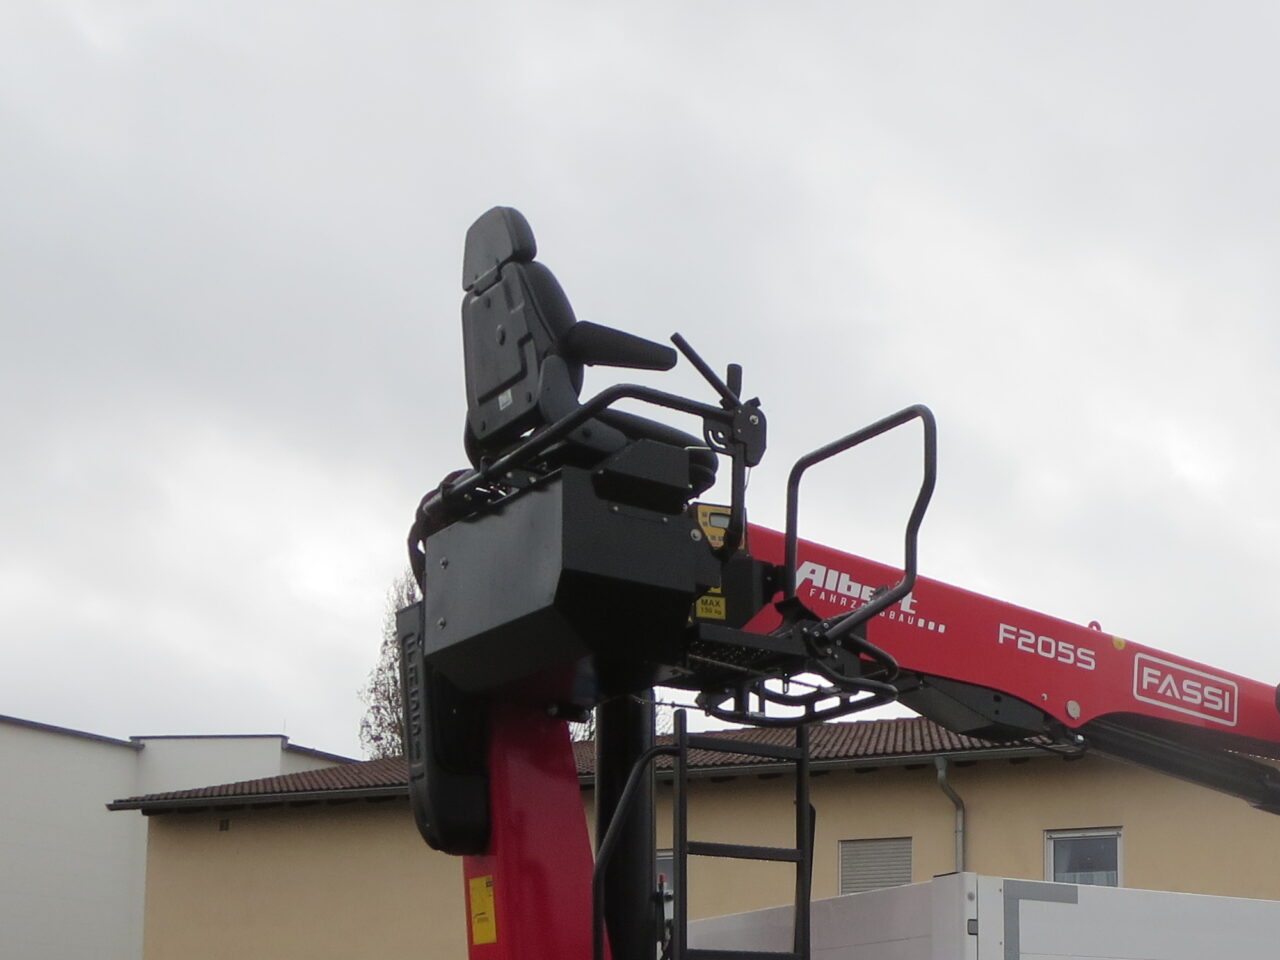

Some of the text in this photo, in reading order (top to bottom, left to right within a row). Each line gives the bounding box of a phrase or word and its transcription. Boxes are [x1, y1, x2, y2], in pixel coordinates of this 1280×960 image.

[701, 599, 720, 607] MAX
[796, 561, 917, 614] Albet
[998, 623, 1095, 670] F205S
[1142, 667, 1230, 713] FASSI
